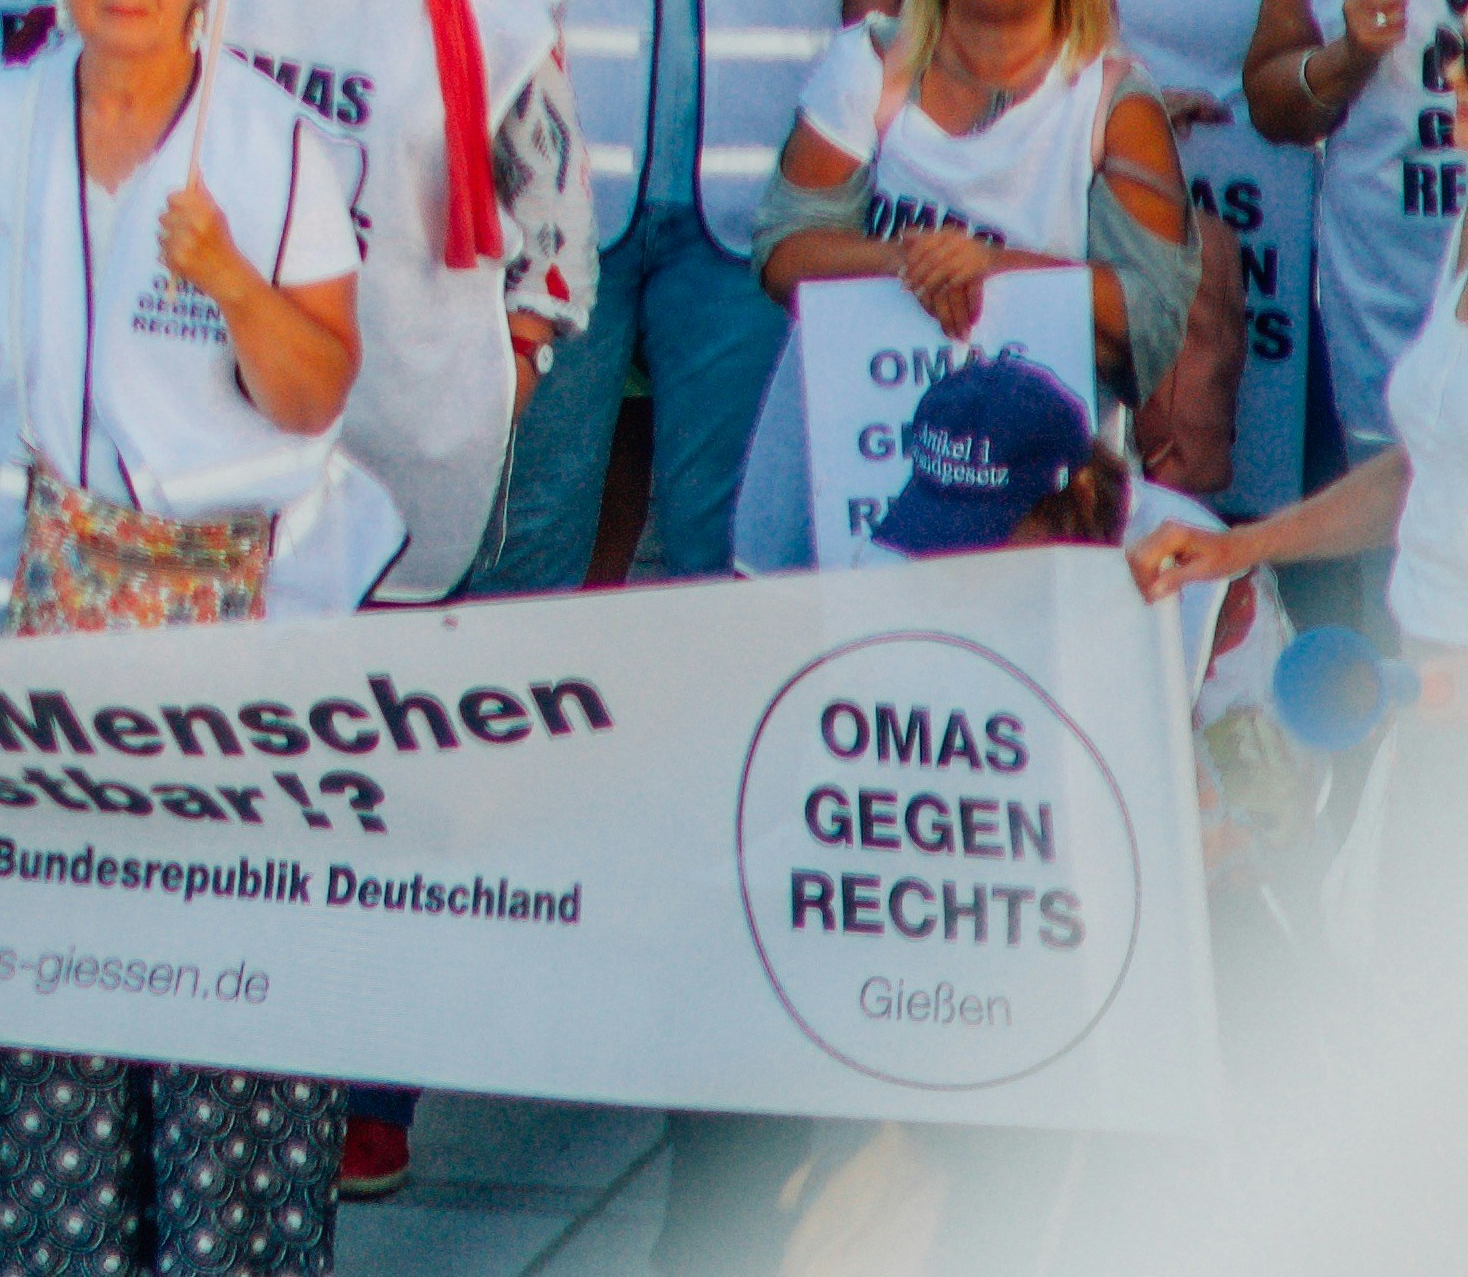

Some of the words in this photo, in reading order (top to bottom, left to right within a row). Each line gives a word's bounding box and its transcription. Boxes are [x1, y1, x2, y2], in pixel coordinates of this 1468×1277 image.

[819, 702, 1030, 775] OMAS
[803, 787, 1056, 865] GEGEN
[325, 864, 583, 926] Deutschland
[790, 869, 1088, 953] RECHTS
[859, 975, 1014, 1029] Gießen
